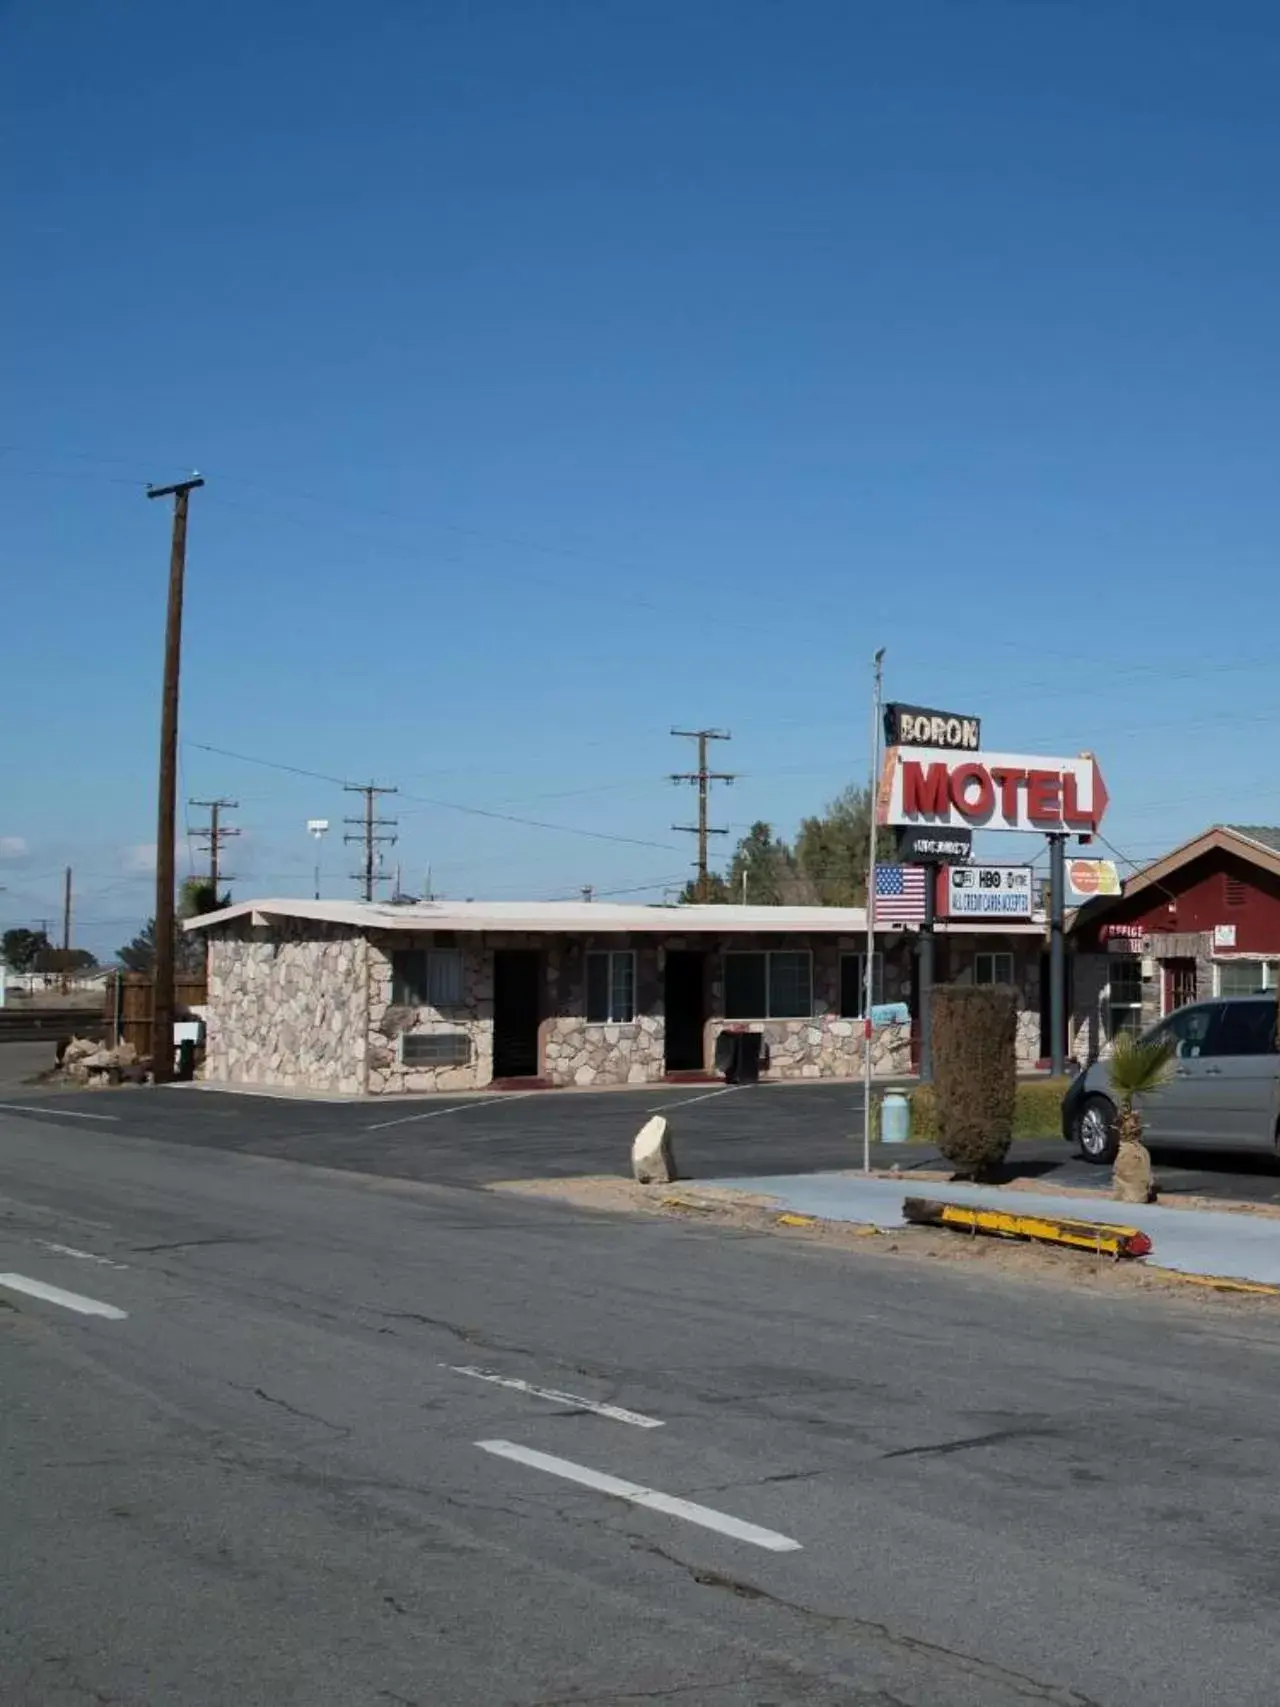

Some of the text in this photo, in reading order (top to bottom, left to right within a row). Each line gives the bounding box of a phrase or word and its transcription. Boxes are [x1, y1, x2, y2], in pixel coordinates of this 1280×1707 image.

[900, 714, 978, 748] BORON
[901, 760, 1095, 827] MOTEL
[979, 870, 1001, 888] HBO
